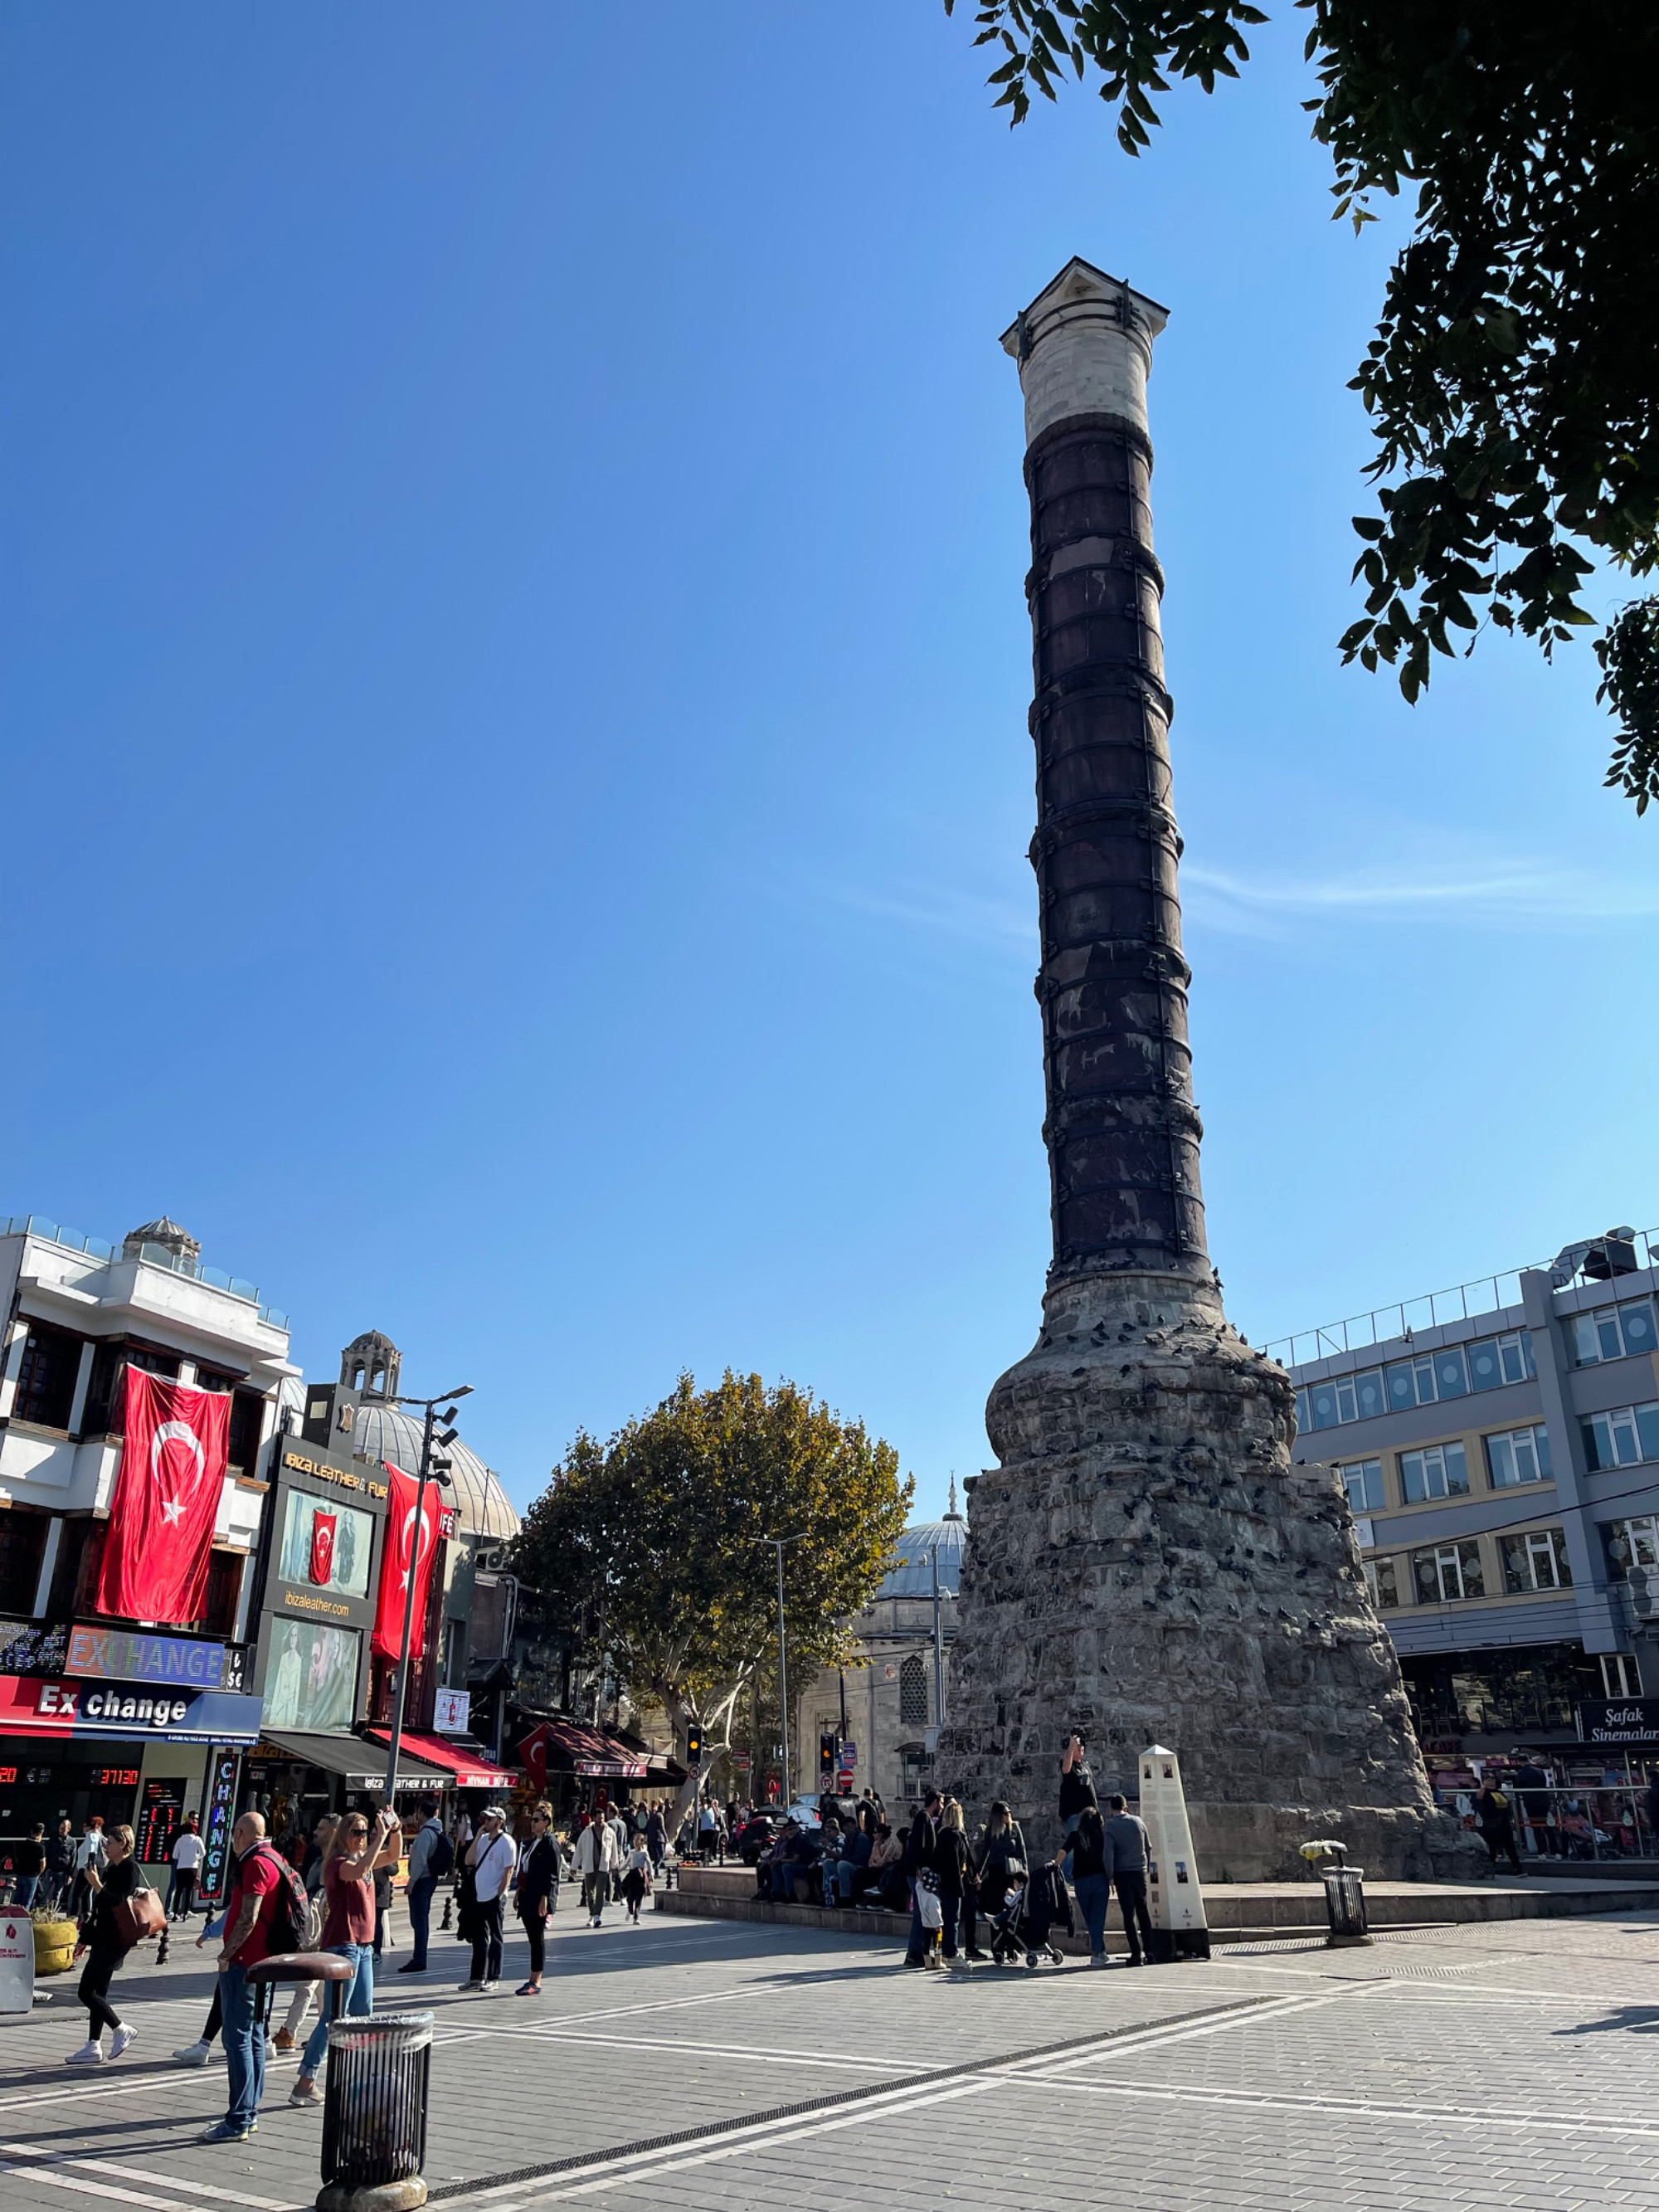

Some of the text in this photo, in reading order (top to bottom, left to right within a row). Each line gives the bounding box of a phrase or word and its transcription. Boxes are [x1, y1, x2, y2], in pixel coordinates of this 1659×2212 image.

[285, 1590, 349, 1617] ibizaleather.com
[40, 1685, 187, 1727] Ex change
[1605, 1707, 1644, 1727] Şafak
[207, 1762, 232, 1892] CHANGE
